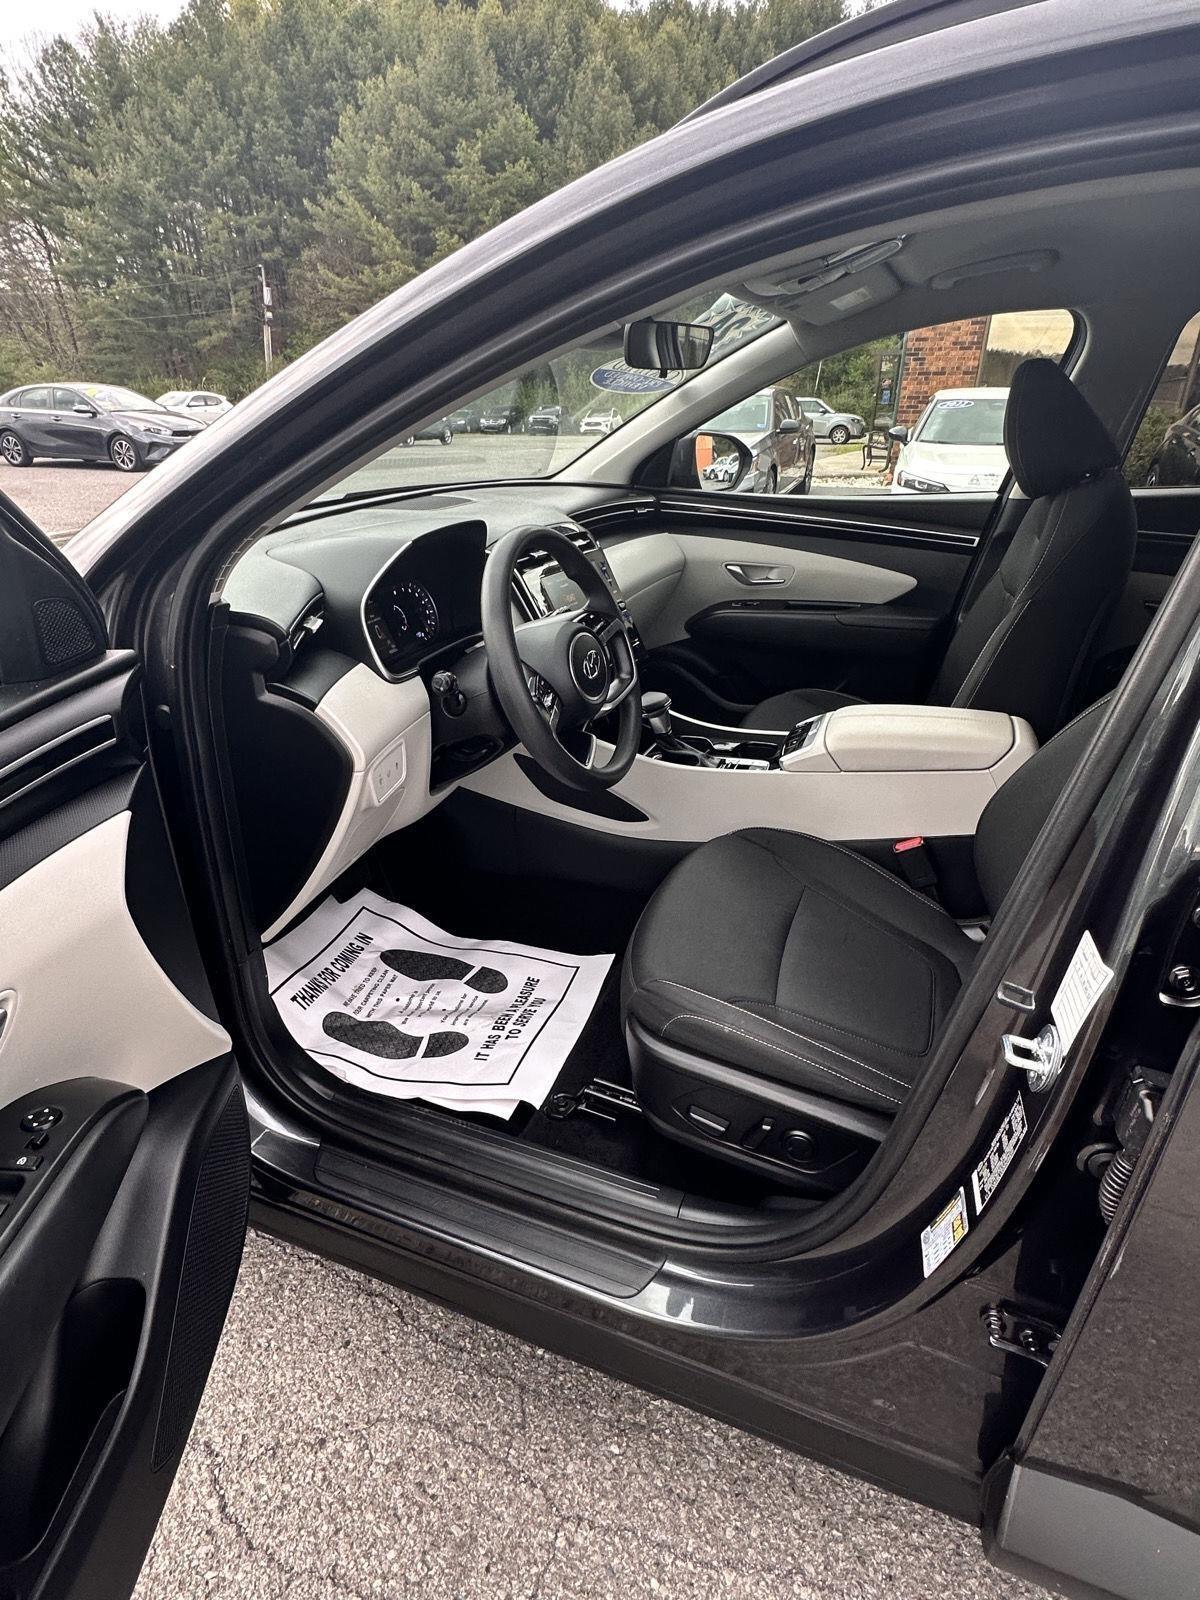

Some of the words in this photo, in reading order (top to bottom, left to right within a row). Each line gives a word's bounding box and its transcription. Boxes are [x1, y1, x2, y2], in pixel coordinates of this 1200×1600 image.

[290, 977, 329, 1011] THANKS
[317, 967, 341, 986] FOR
[330, 942, 365, 973] COMING
[354, 932, 374, 946] IN
[366, 966, 380, 979] KEEP
[362, 975, 372, 986] TO
[352, 1005, 364, 1016] YOUR
[360, 981, 382, 1006] CARPETING
[375, 969, 389, 985] CLEAN
[353, 982, 366, 997] TRIED
[510, 976, 540, 1011] PLEASURE
[365, 1007, 378, 1018] WITH
[372, 997, 383, 1010] THIS
[379, 981, 393, 998] PAPER
[528, 997, 546, 1007] YOU
[491, 1013, 513, 1031] BEEN
[512, 1005, 537, 1027] SERVE
[480, 1034, 501, 1049] HAS
[504, 1028, 522, 1040] TO
[473, 1052, 490, 1061] IT
